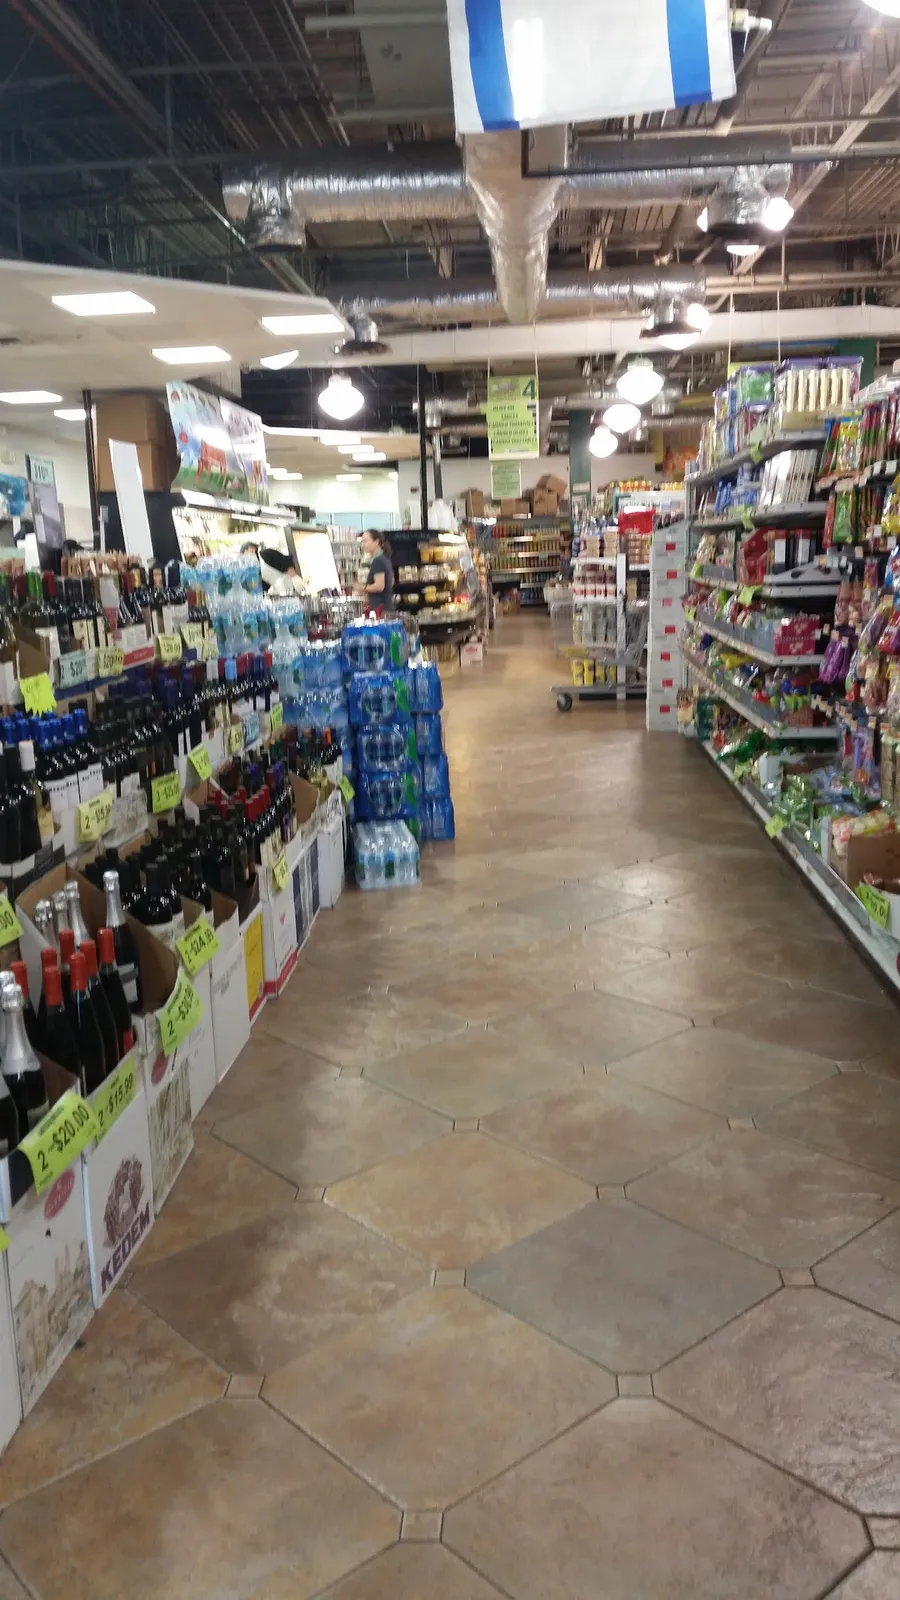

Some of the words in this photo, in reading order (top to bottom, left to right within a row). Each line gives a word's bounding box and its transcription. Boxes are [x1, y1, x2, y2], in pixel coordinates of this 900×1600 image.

[522, 379, 537, 400] 4
[84, 815, 91, 829] 2
[167, 1020, 175, 1037] 2
[97, 1109, 104, 1127] 2
[37, 1150, 49, 1172] 2
[100, 1201, 151, 1294] KEDEM
